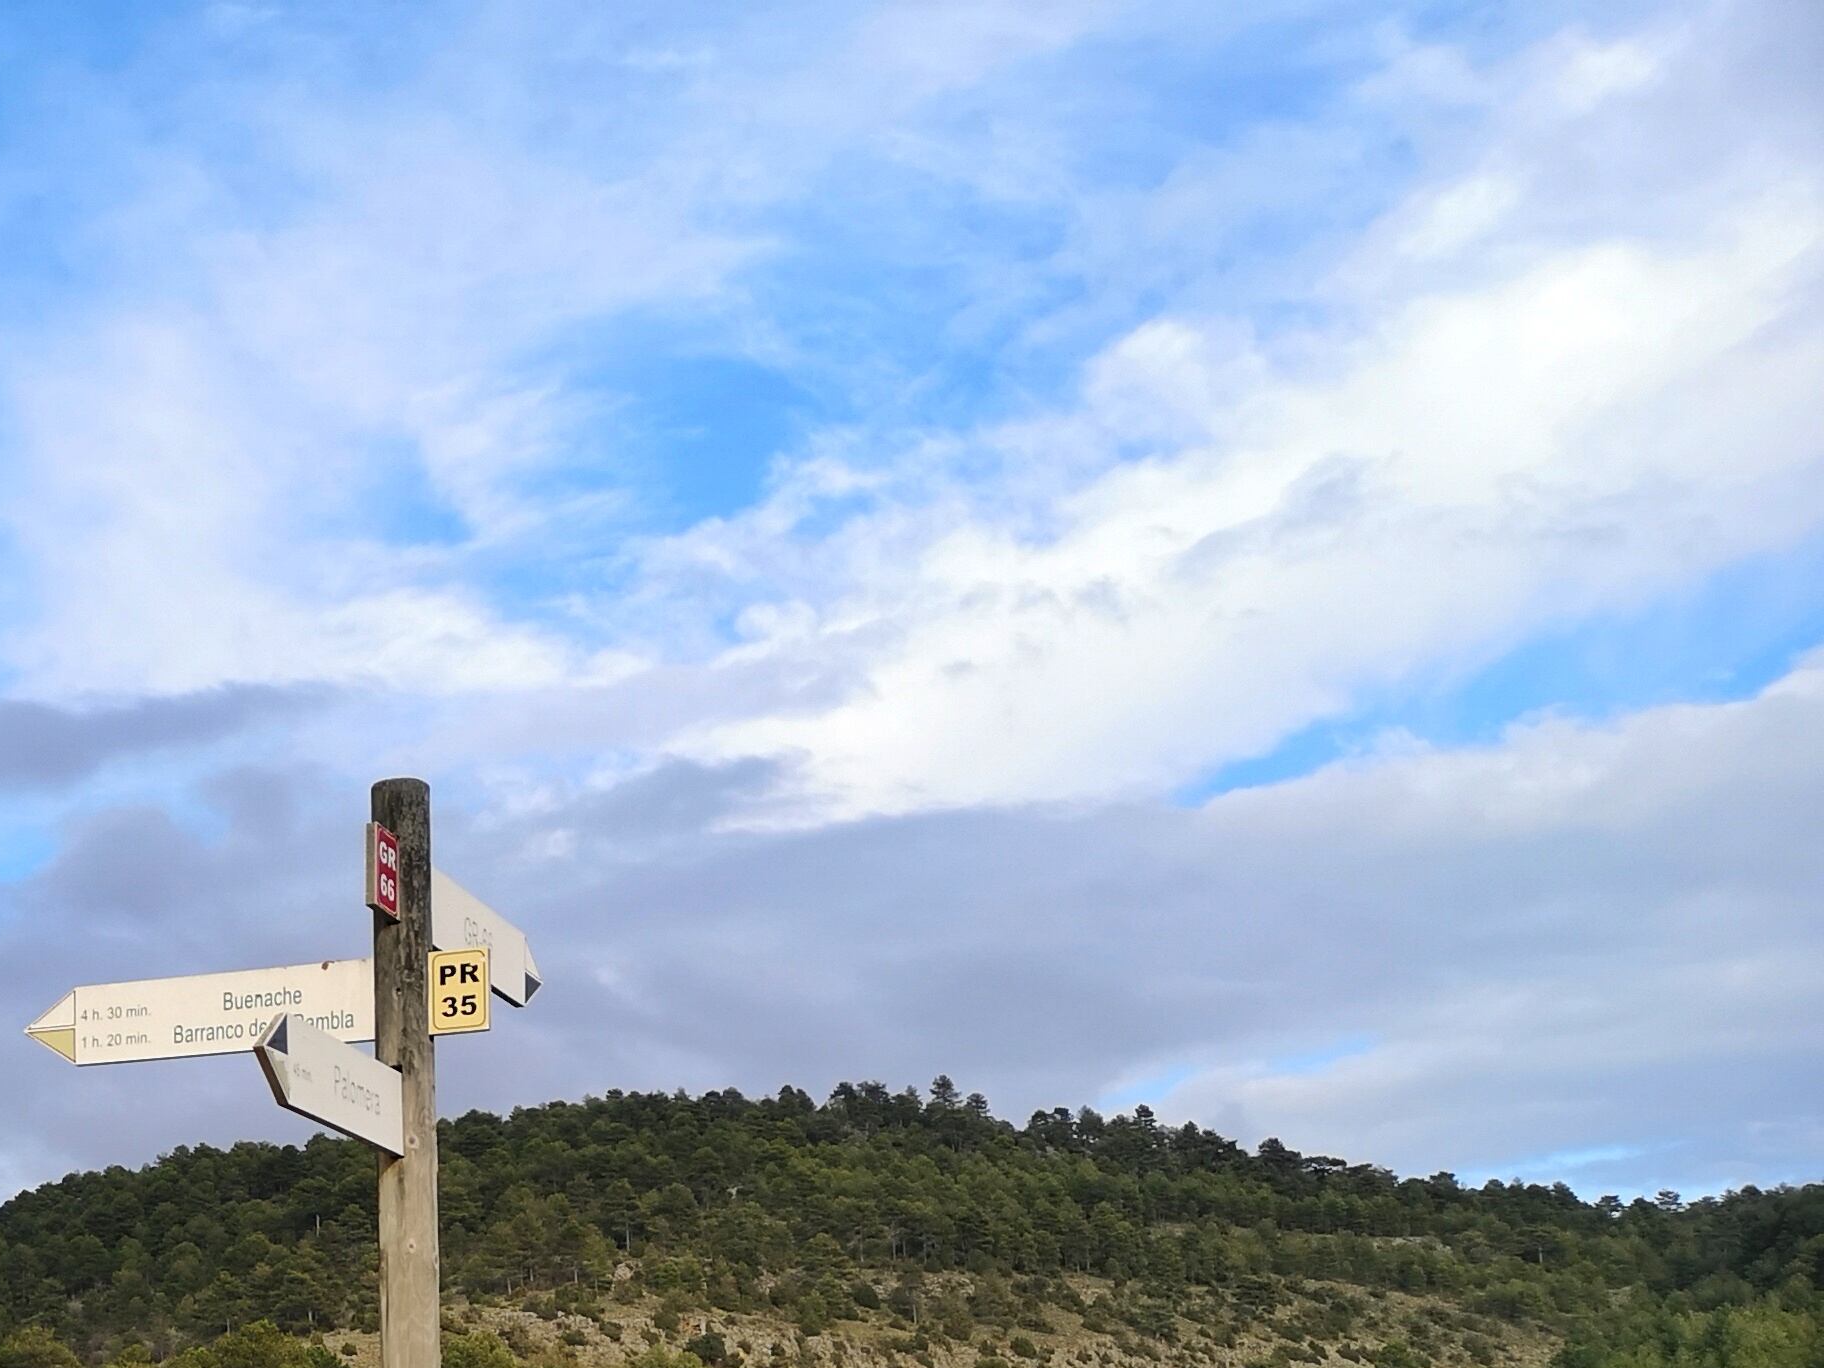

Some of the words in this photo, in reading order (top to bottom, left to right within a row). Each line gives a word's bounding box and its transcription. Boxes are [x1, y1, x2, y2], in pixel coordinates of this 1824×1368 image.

[379, 841, 396, 872] GR
[380, 873, 395, 902] 66
[439, 962, 480, 986] PR
[223, 986, 303, 1011] Buenache
[441, 994, 478, 1018] 35
[81, 1009, 88, 1021] 4
[107, 1006, 123, 1019] 30
[126, 1004, 152, 1017] min.
[81, 1036, 88, 1048] 1
[106, 1033, 123, 1046] 20
[126, 1031, 151, 1044] min.
[173, 1022, 244, 1044] Barranco
[333, 1064, 381, 1116] Palomera
